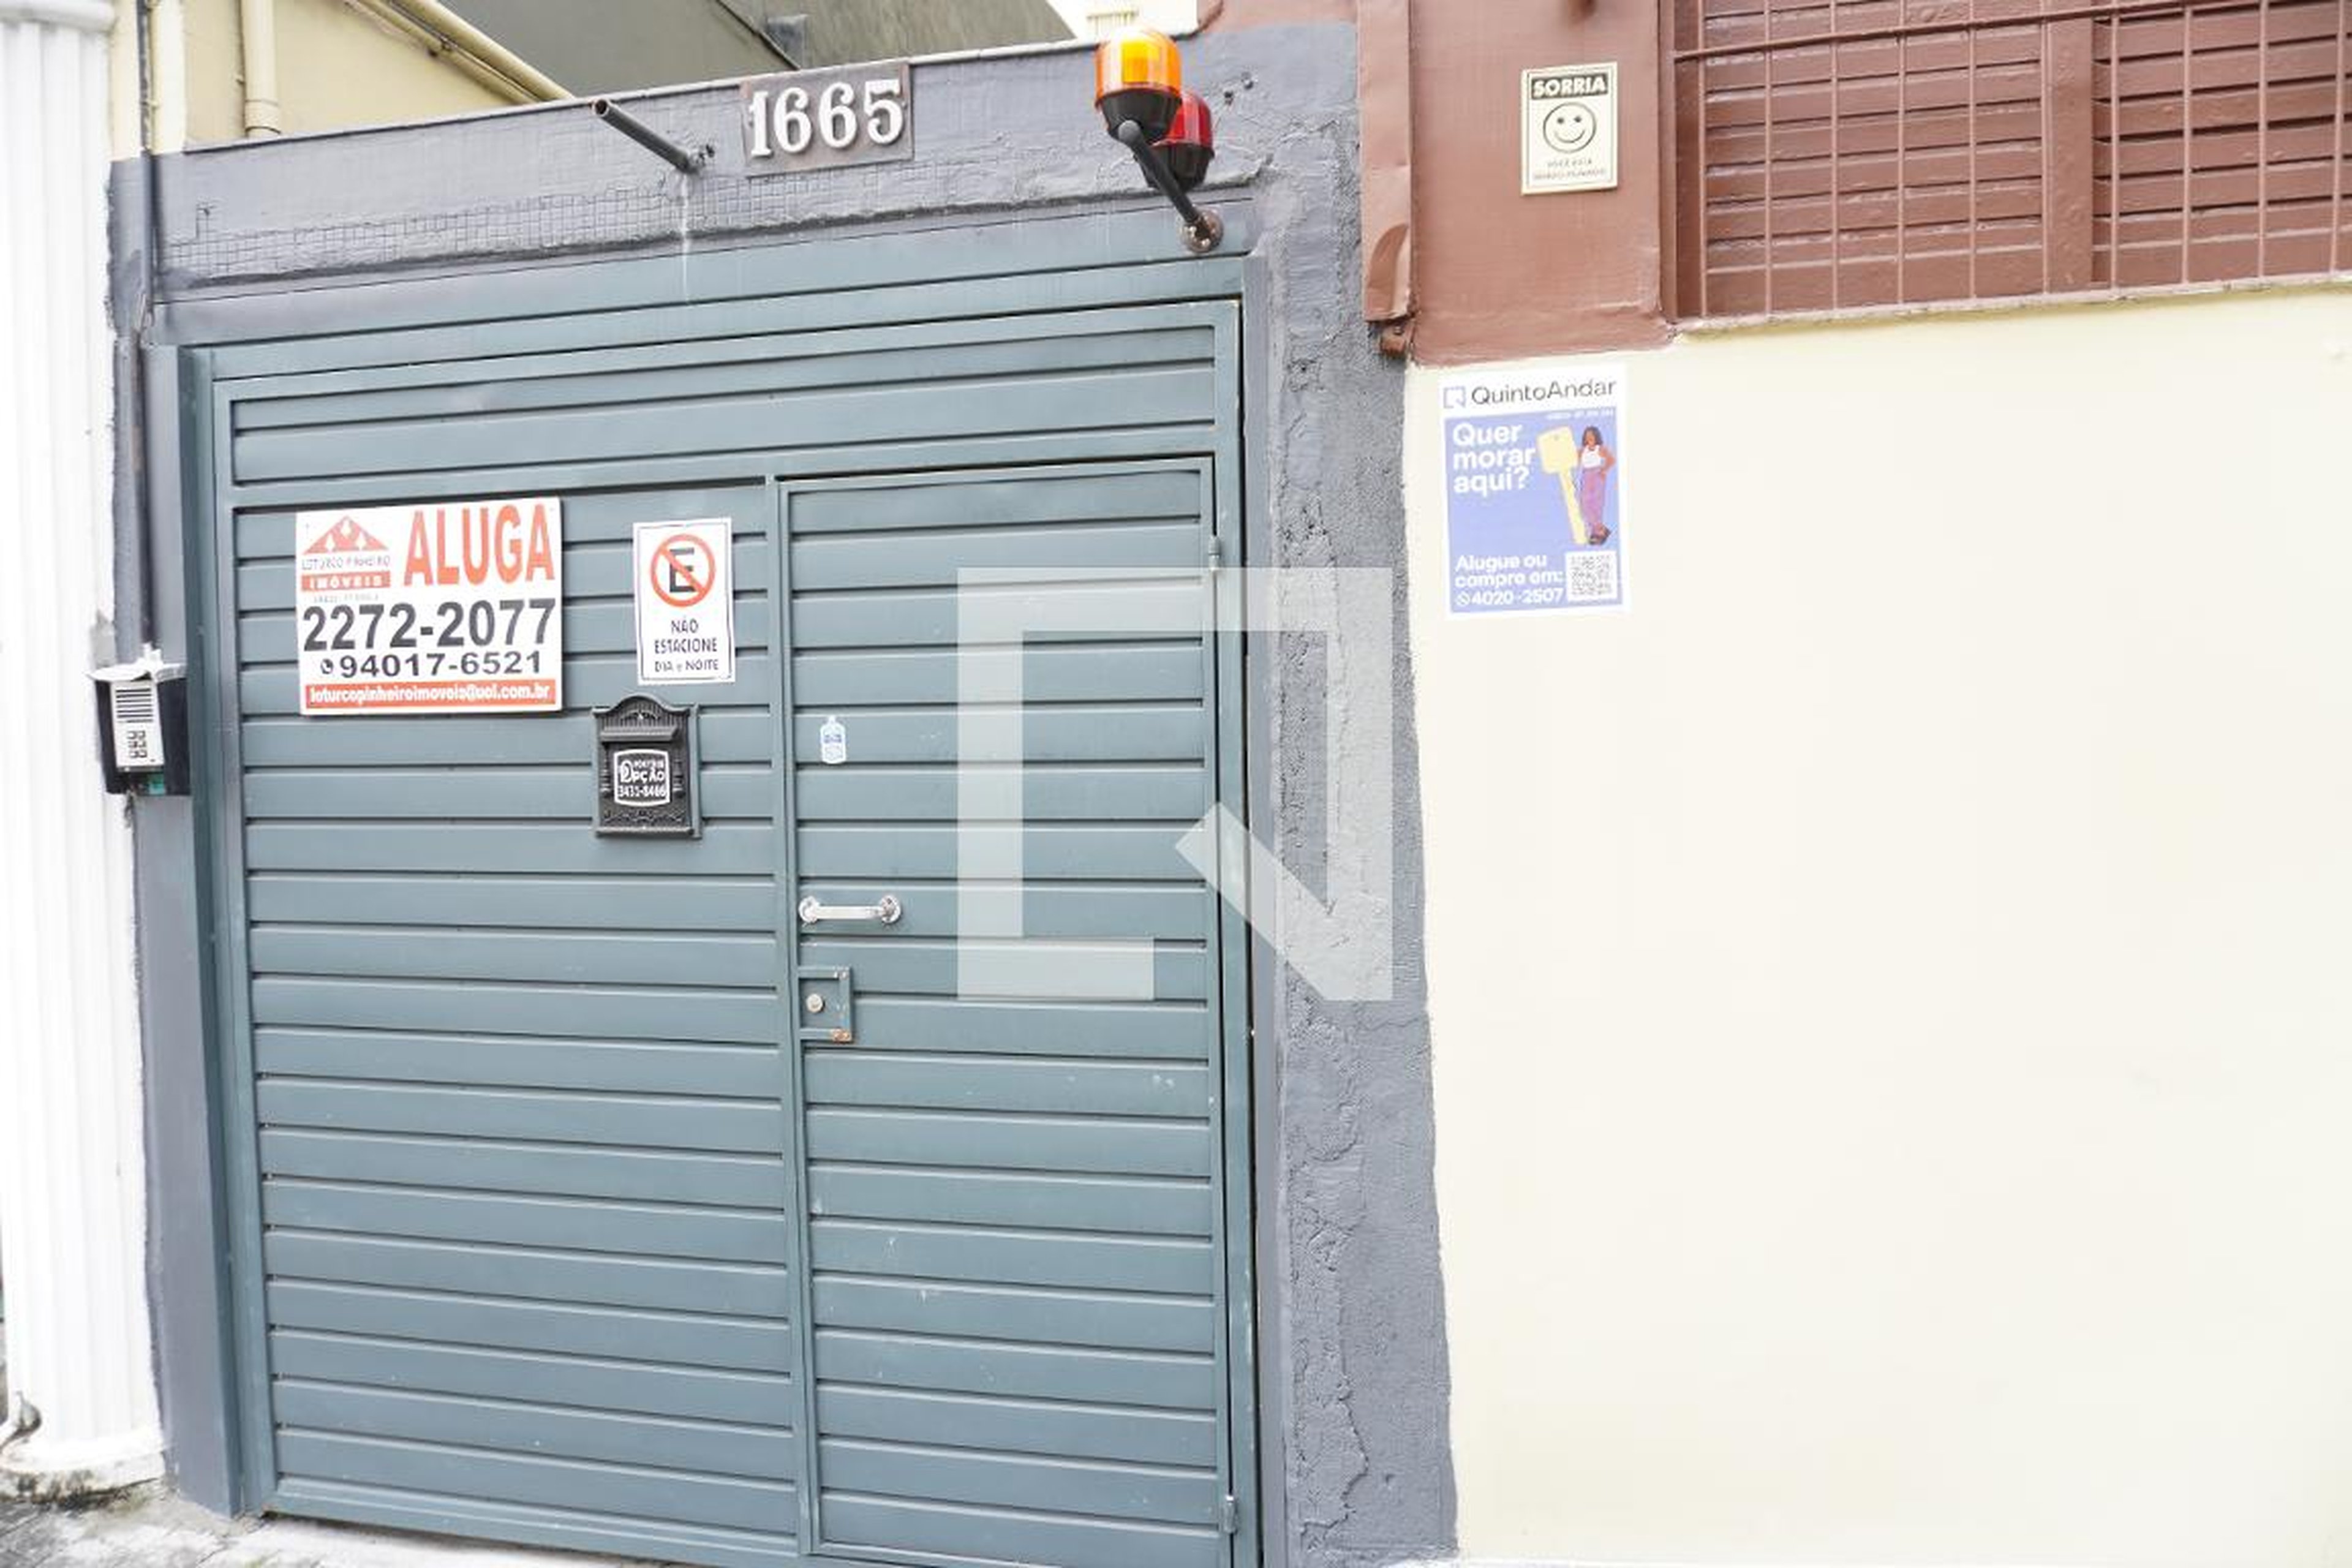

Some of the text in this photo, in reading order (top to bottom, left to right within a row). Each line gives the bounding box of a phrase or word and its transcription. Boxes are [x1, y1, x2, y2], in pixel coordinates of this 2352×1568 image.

[1533, 76, 1606, 97] SORRIA
[749, 79, 903, 157] 1665
[1471, 379, 1616, 405] QuintoAndar
[1453, 423, 1523, 445] Quer
[1453, 447, 1536, 470] morar
[1454, 468, 1530, 497] aqui?
[404, 503, 555, 587] ALUGA
[1455, 554, 1547, 573] Alugue ou
[1455, 571, 1564, 588] compre em:
[1471, 587, 1564, 605] 4020-2507
[303, 598, 556, 652] 2272-2077
[671, 615, 699, 634] NÃO
[654, 638, 718, 654] ESTACIONE
[339, 650, 540, 679] 94017-6521
[655, 661, 673, 672] DIA
[685, 659, 718, 671] NOITE
